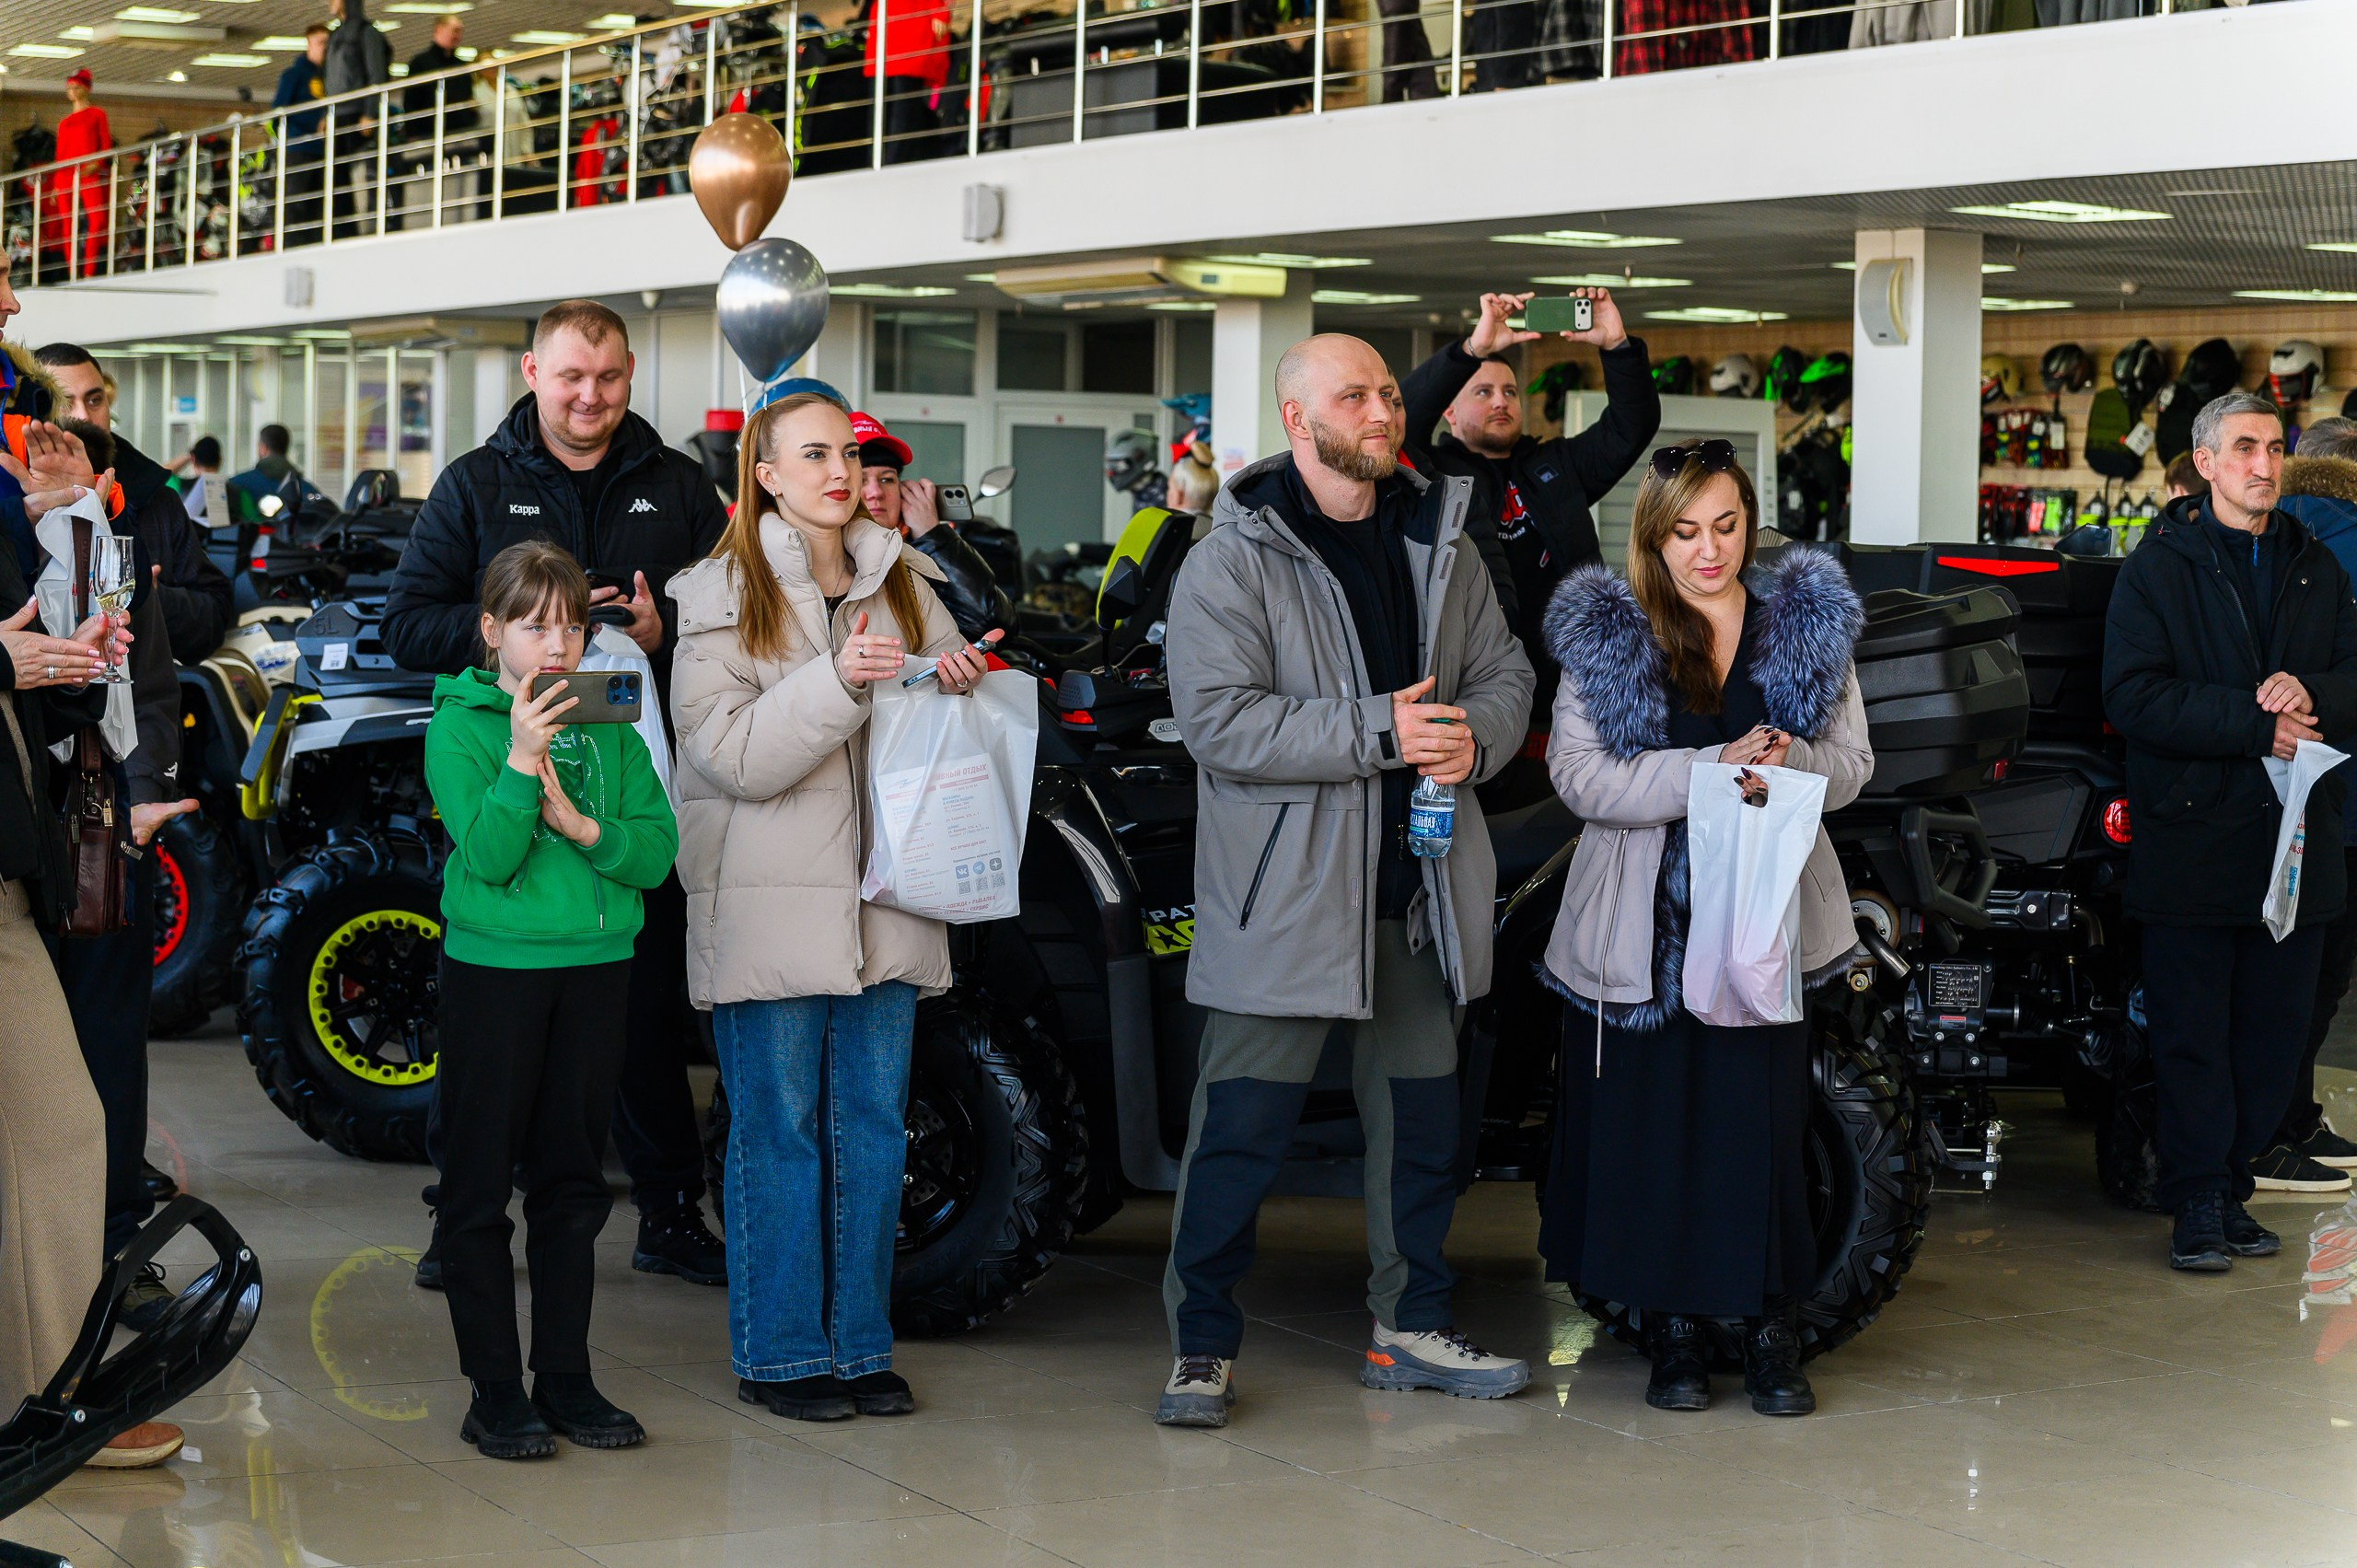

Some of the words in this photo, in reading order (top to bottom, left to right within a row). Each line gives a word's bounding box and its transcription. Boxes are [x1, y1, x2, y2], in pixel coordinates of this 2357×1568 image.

[509, 505, 540, 516] Kappa
[316, 614, 339, 635] 5L
[963, 763, 987, 774] ОТДЫХ
